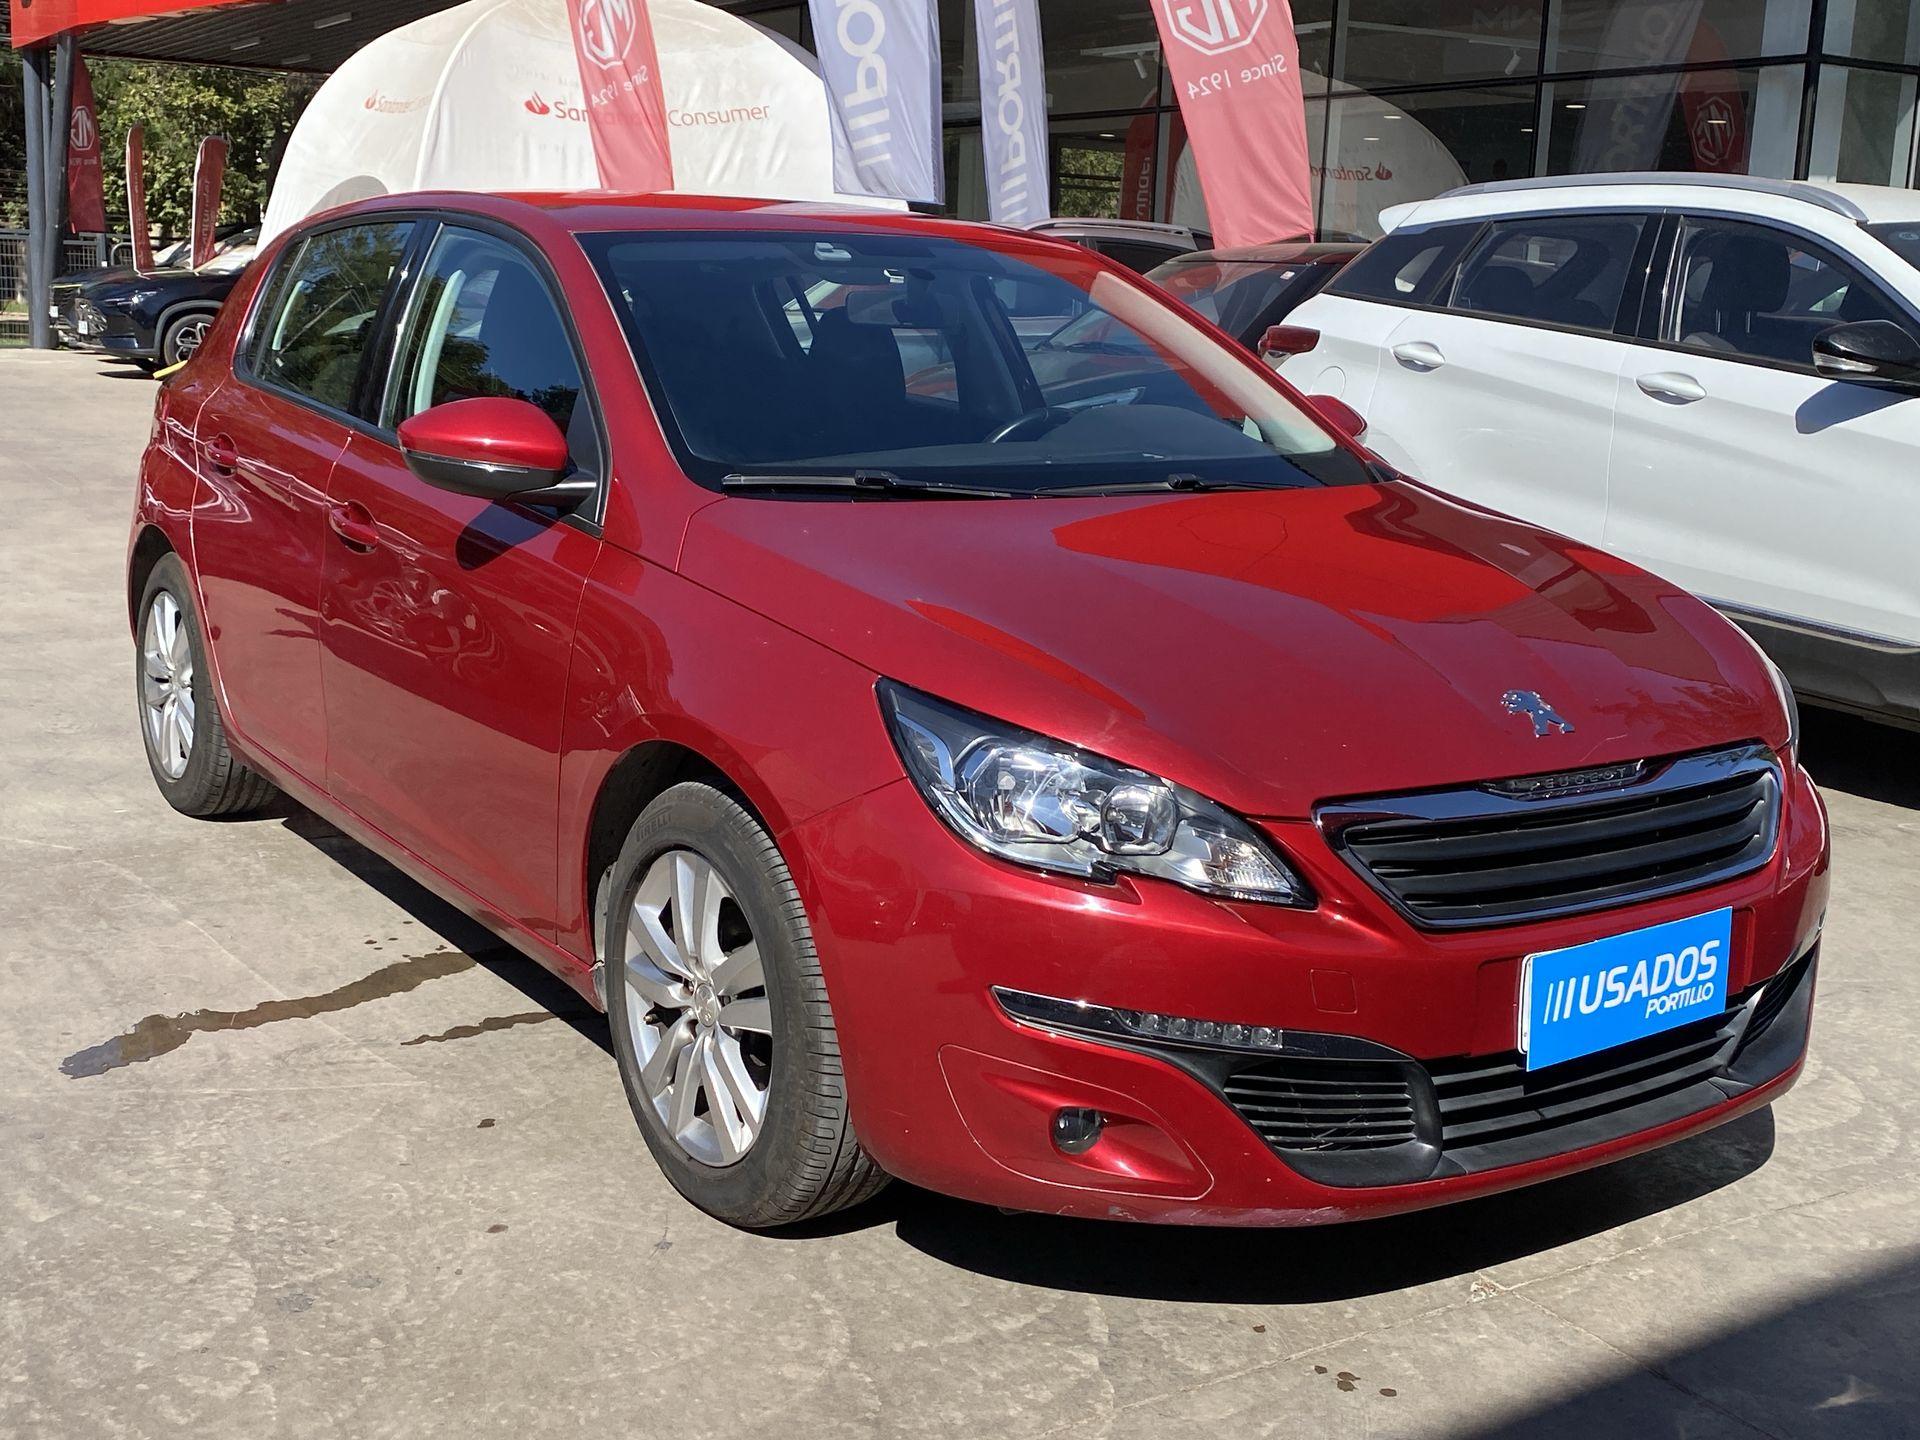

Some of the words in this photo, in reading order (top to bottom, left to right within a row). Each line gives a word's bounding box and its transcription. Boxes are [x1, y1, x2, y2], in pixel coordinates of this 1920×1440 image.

[668, 105, 770, 127] Consumer
[1579, 939, 1720, 1014] USADOS
[1645, 982, 1715, 1019] PORTILLO
